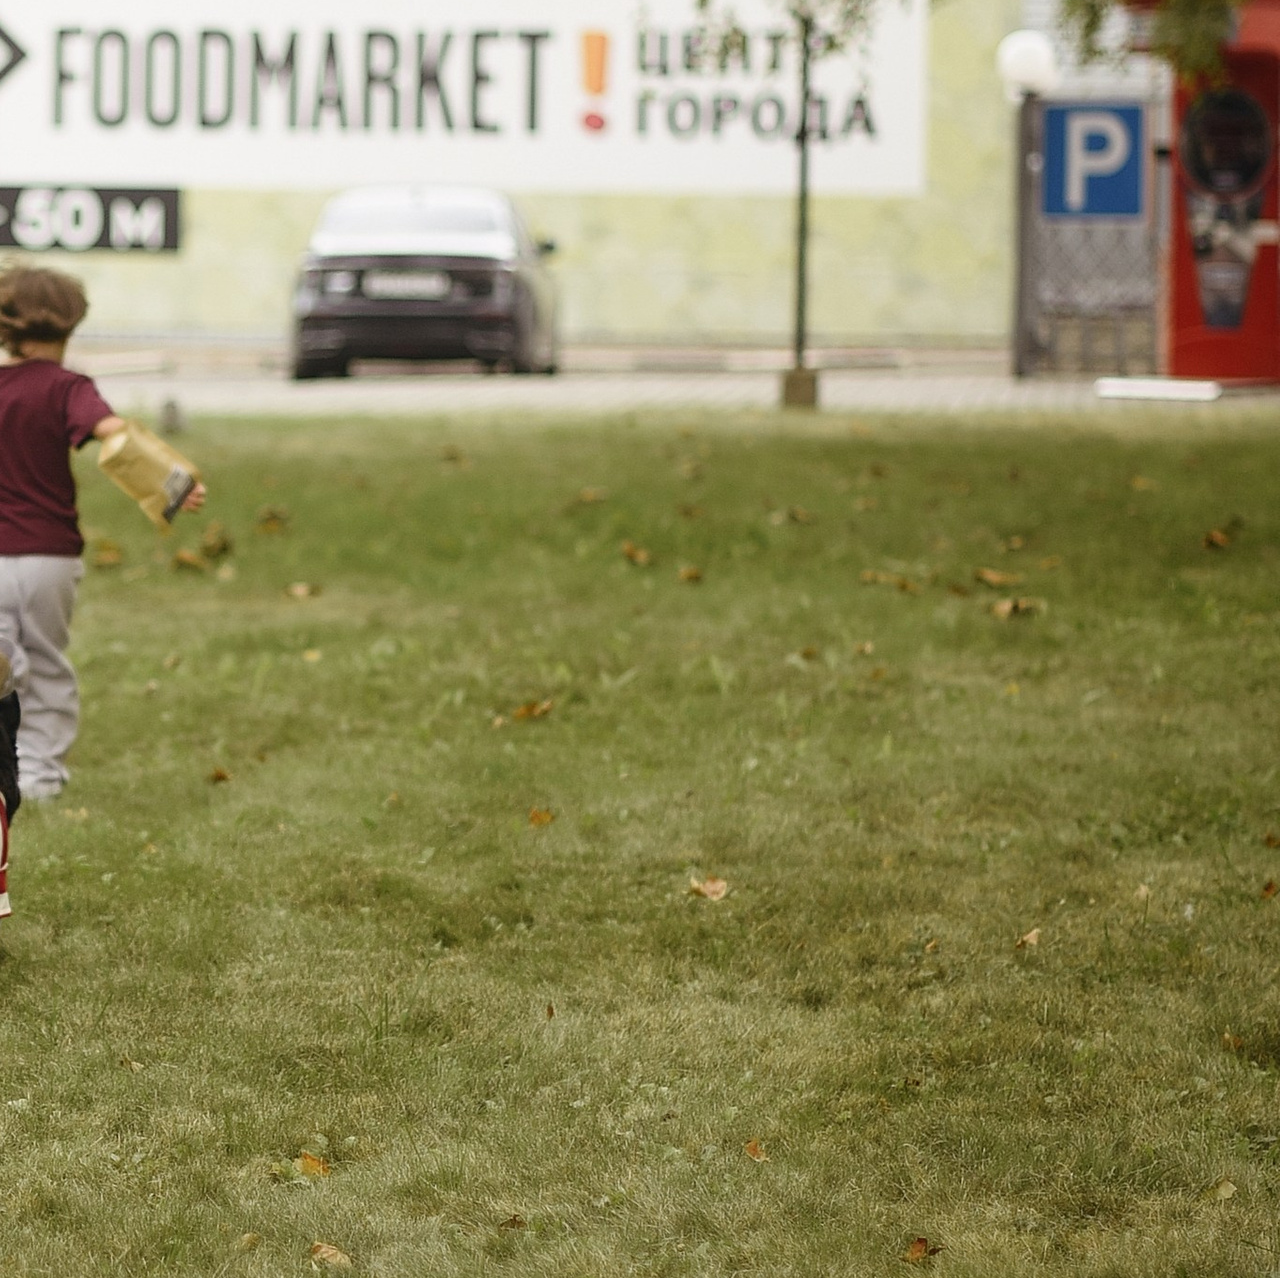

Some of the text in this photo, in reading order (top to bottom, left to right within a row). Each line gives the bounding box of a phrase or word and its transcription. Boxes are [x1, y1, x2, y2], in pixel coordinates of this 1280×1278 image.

[635, 91, 878, 142] ГОРОДА
[1065, 110, 1131, 211] P
[11, 187, 105, 252] 50
